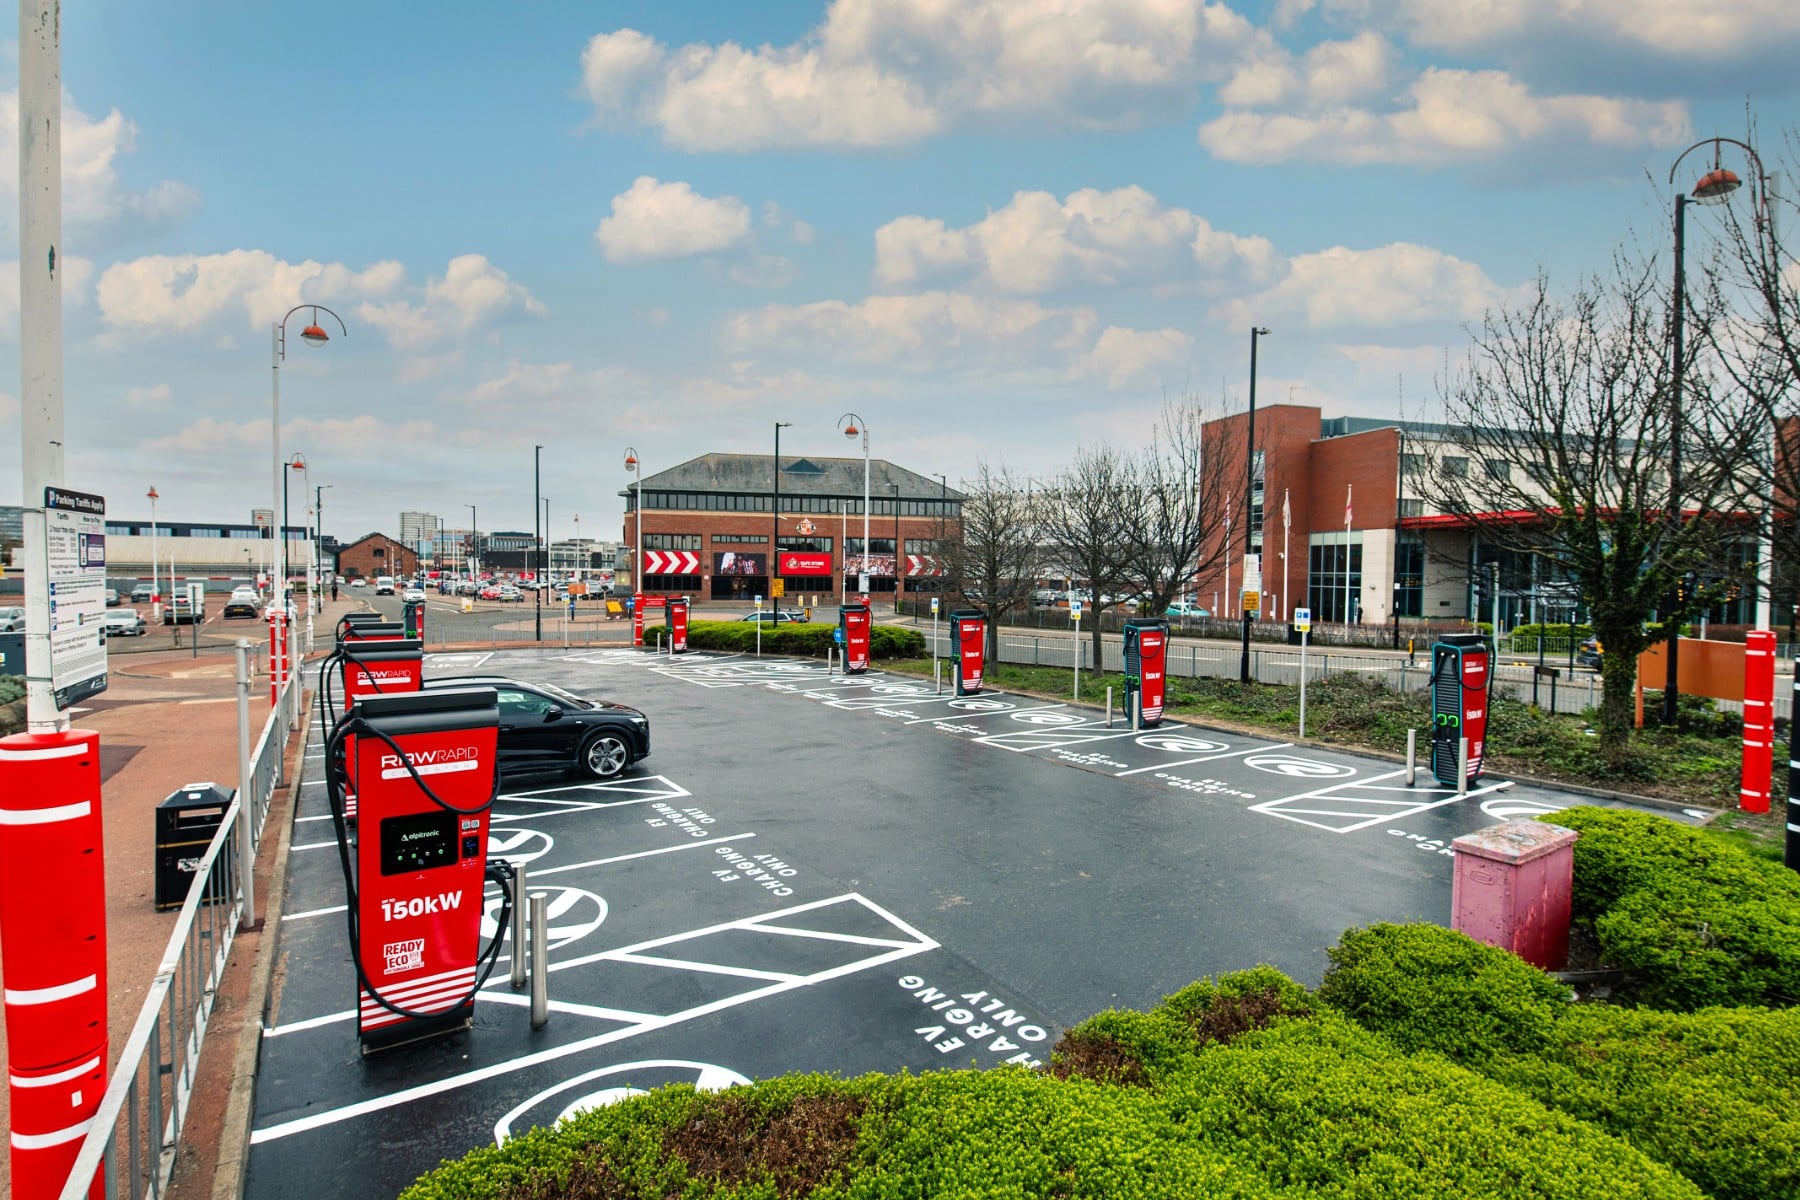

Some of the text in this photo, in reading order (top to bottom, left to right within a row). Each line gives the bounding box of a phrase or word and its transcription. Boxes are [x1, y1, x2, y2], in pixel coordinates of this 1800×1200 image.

[55, 494, 75, 508] Parking
[76, 497, 91, 508] Tariffs
[92, 500, 104, 512] Apply
[1154, 772, 1256, 799] CHARGING
[645, 818, 668, 828] EV
[651, 802, 708, 837] CHARGING
[681, 807, 716, 824] ONLY
[711, 869, 741, 882] EV
[715, 847, 794, 897] CHARGING
[752, 854, 797, 877] ONLY
[381, 890, 462, 922] 150kW
[385, 940, 422, 956] READY
[389, 954, 409, 968] ECO
[898, 975, 1042, 1069] HARGING
[960, 990, 1047, 1042] ONLY
[914, 1025, 966, 1054] EV
